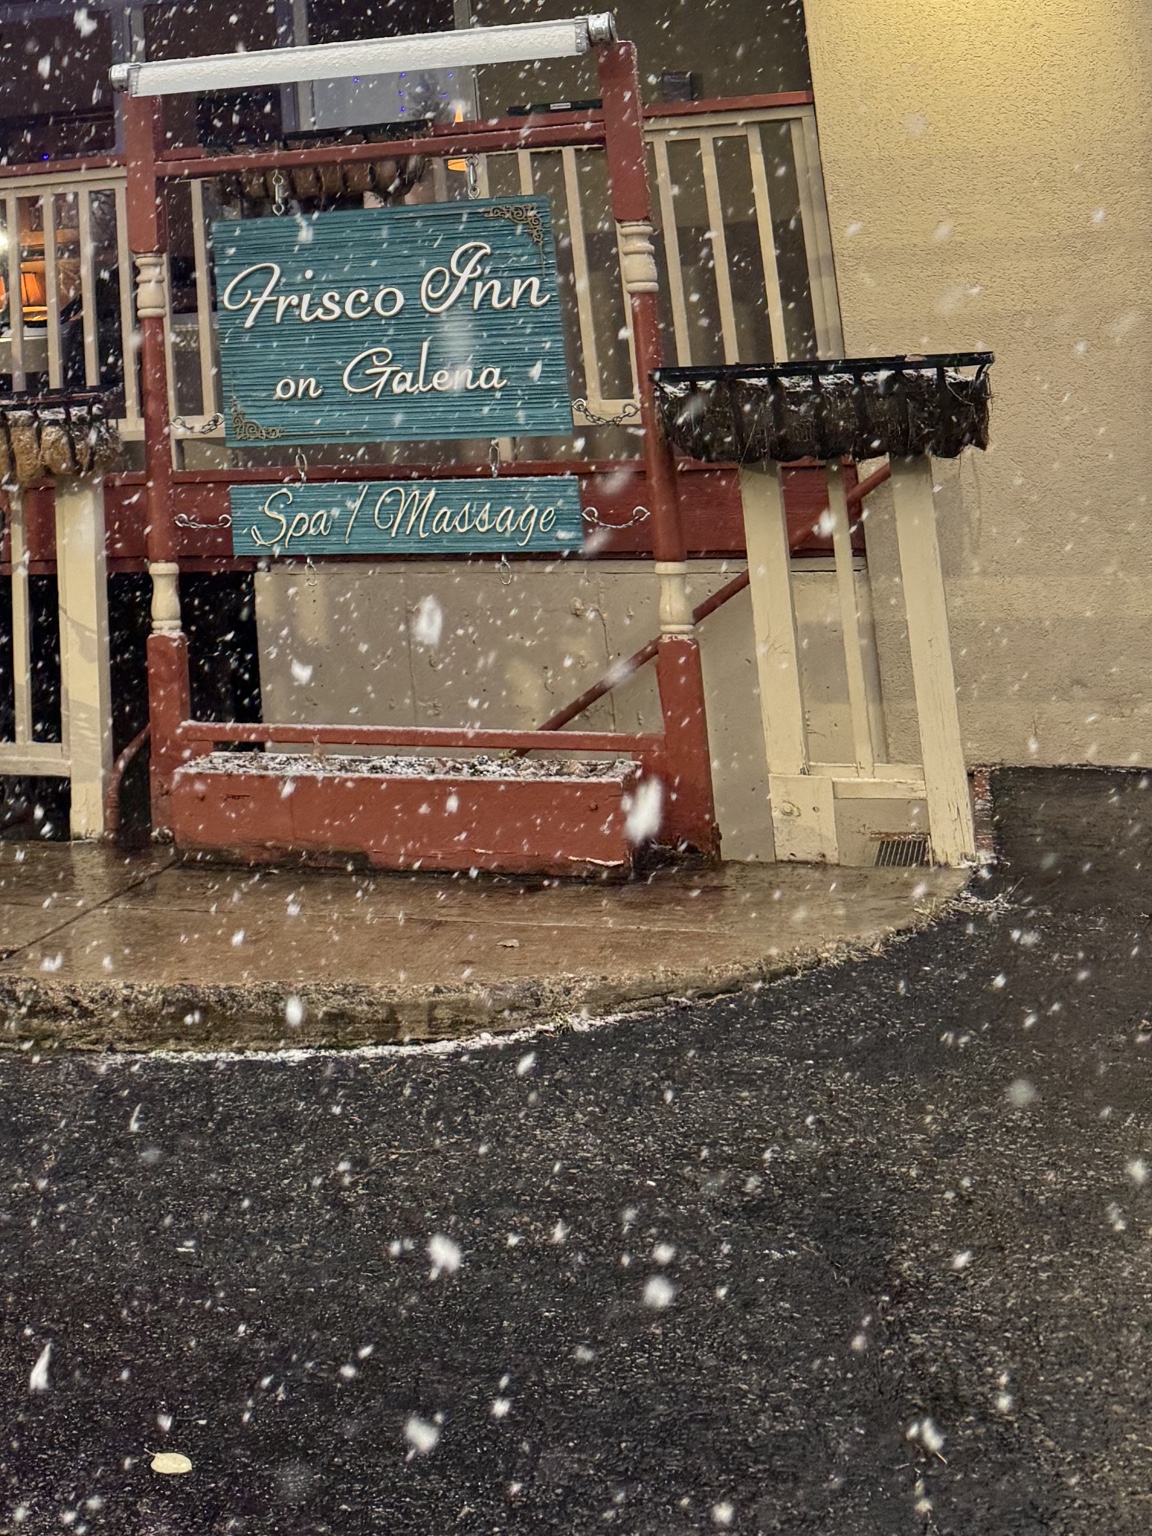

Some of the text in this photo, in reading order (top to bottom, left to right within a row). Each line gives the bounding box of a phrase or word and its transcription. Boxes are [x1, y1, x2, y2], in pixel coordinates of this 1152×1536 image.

[223, 242, 551, 329] Frisco Inn
[274, 341, 507, 401] on Galena
[251, 489, 331, 548] Spa
[374, 487, 557, 546] Massage
